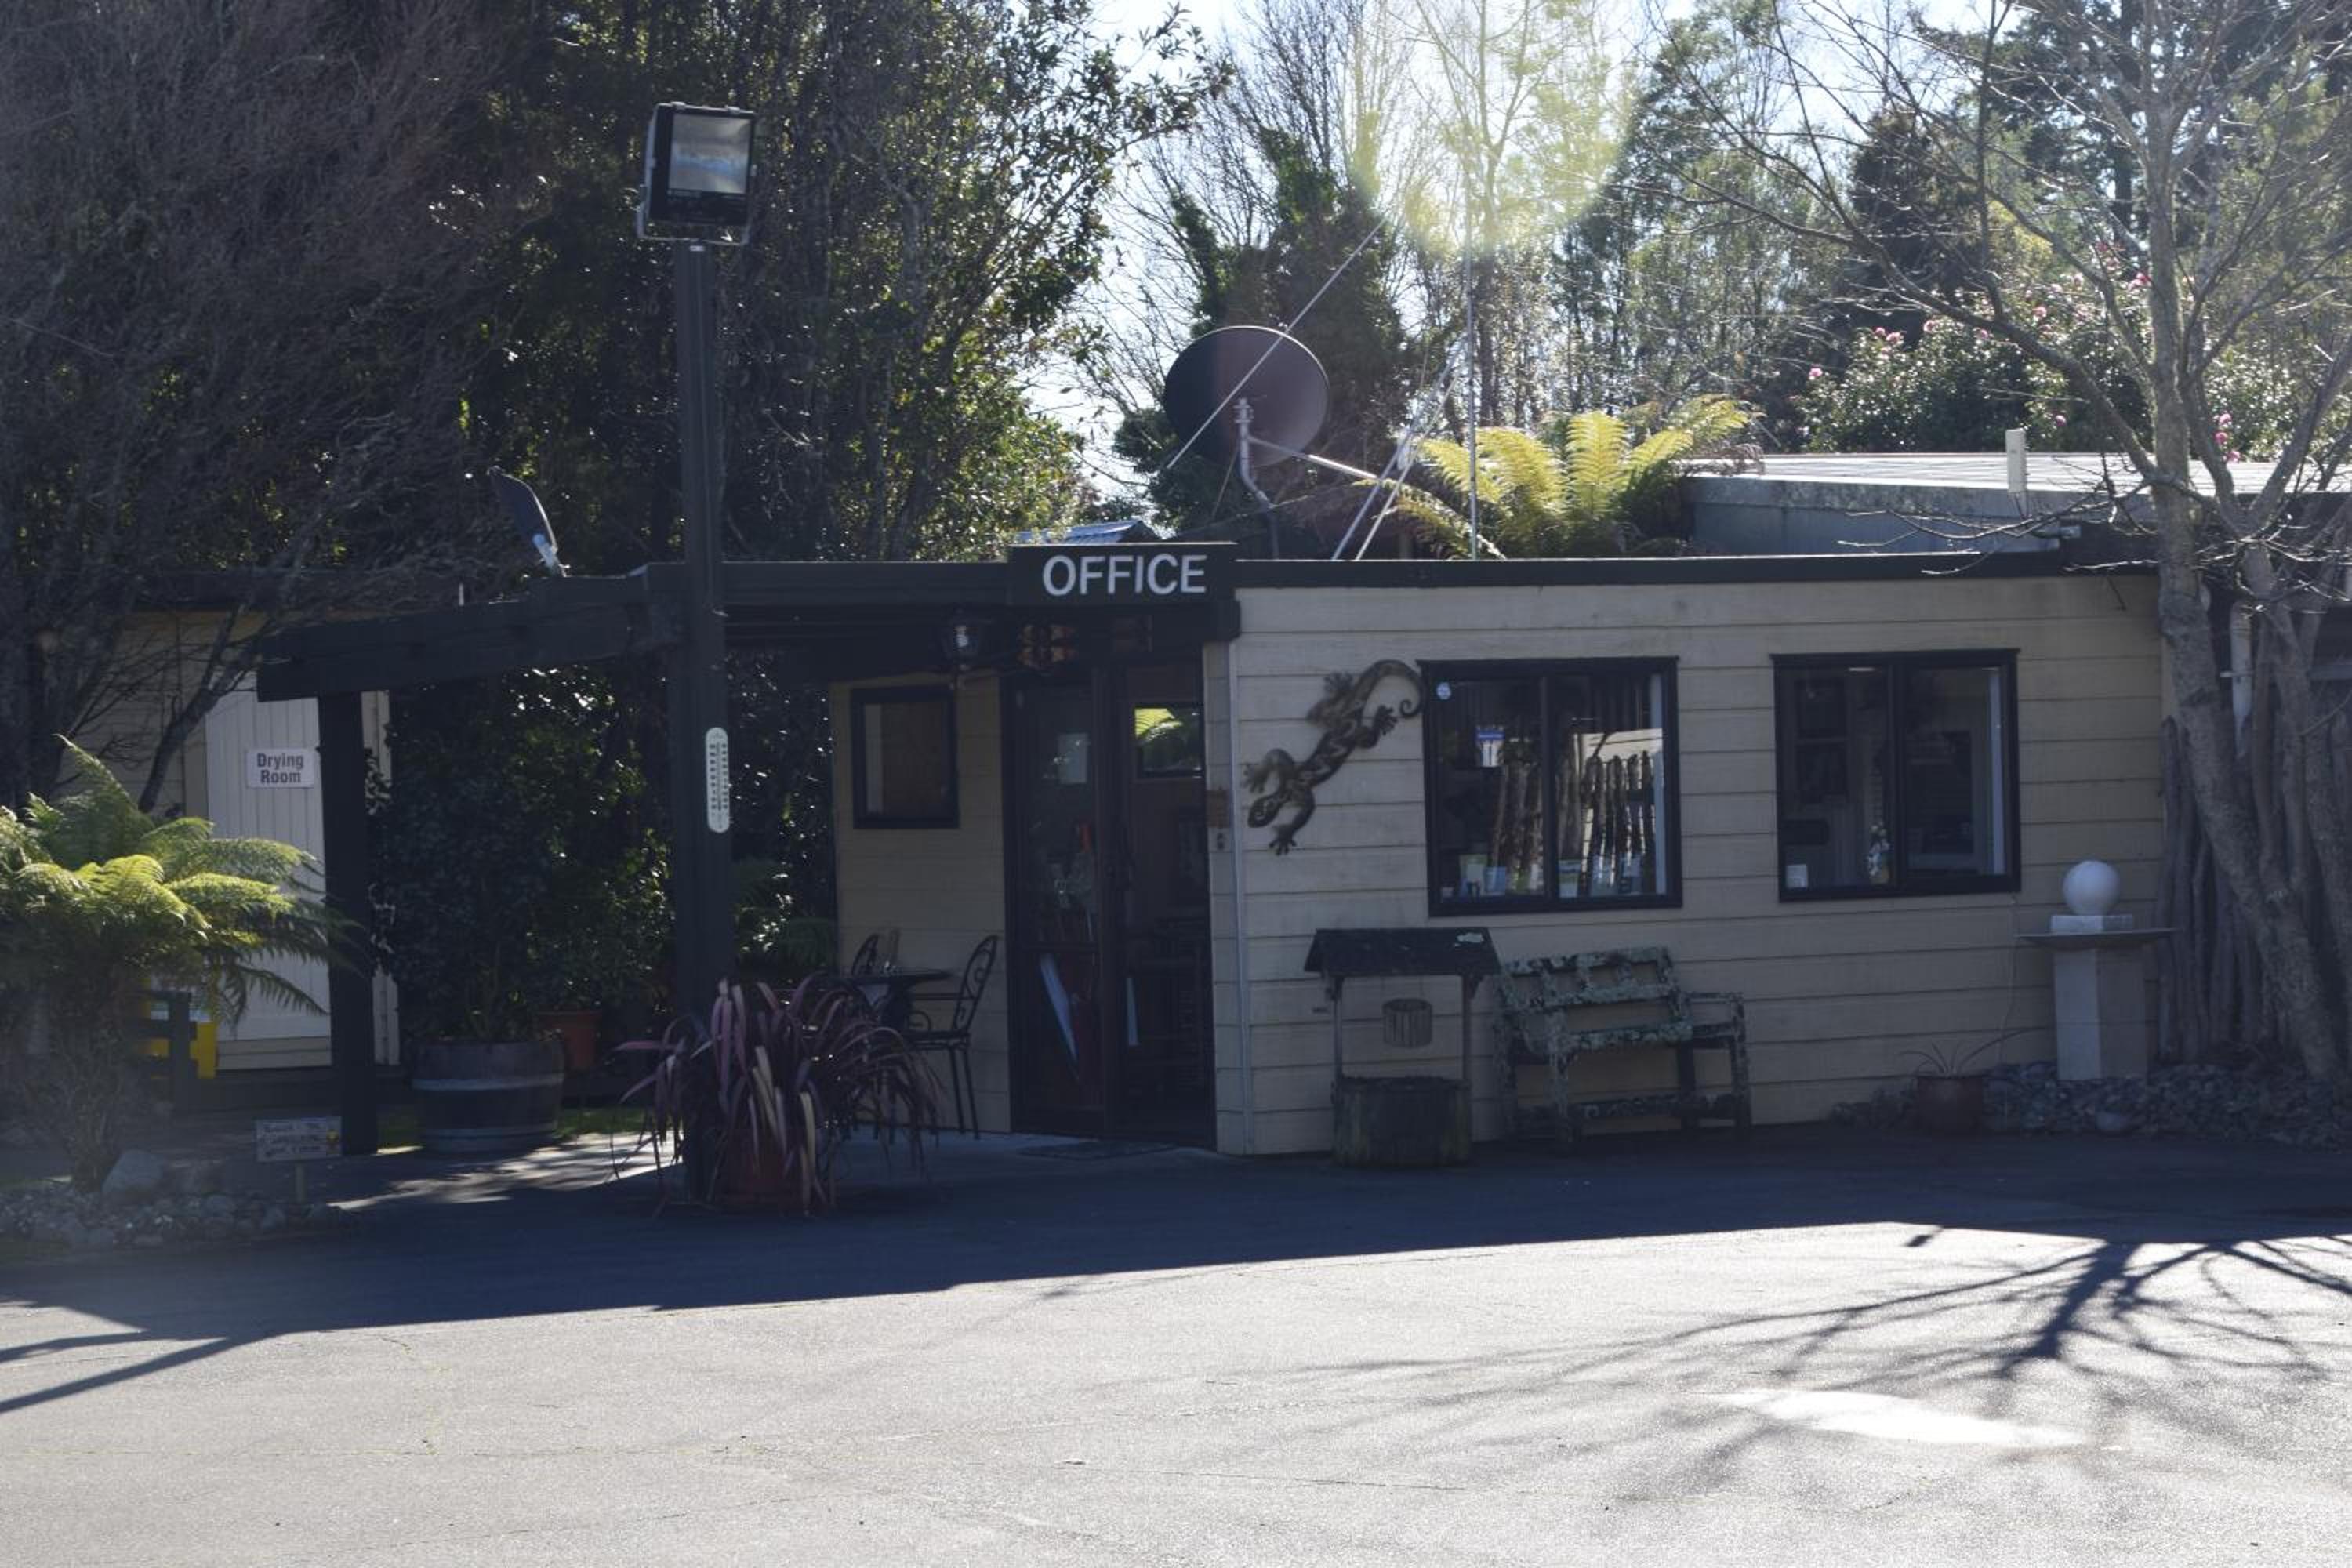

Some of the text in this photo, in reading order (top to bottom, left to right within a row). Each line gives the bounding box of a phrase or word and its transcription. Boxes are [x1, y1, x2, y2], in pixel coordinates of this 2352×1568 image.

[1043, 554, 1208, 596] OFFICE
[257, 753, 303, 770] Drying
[261, 769, 301, 784] Room
